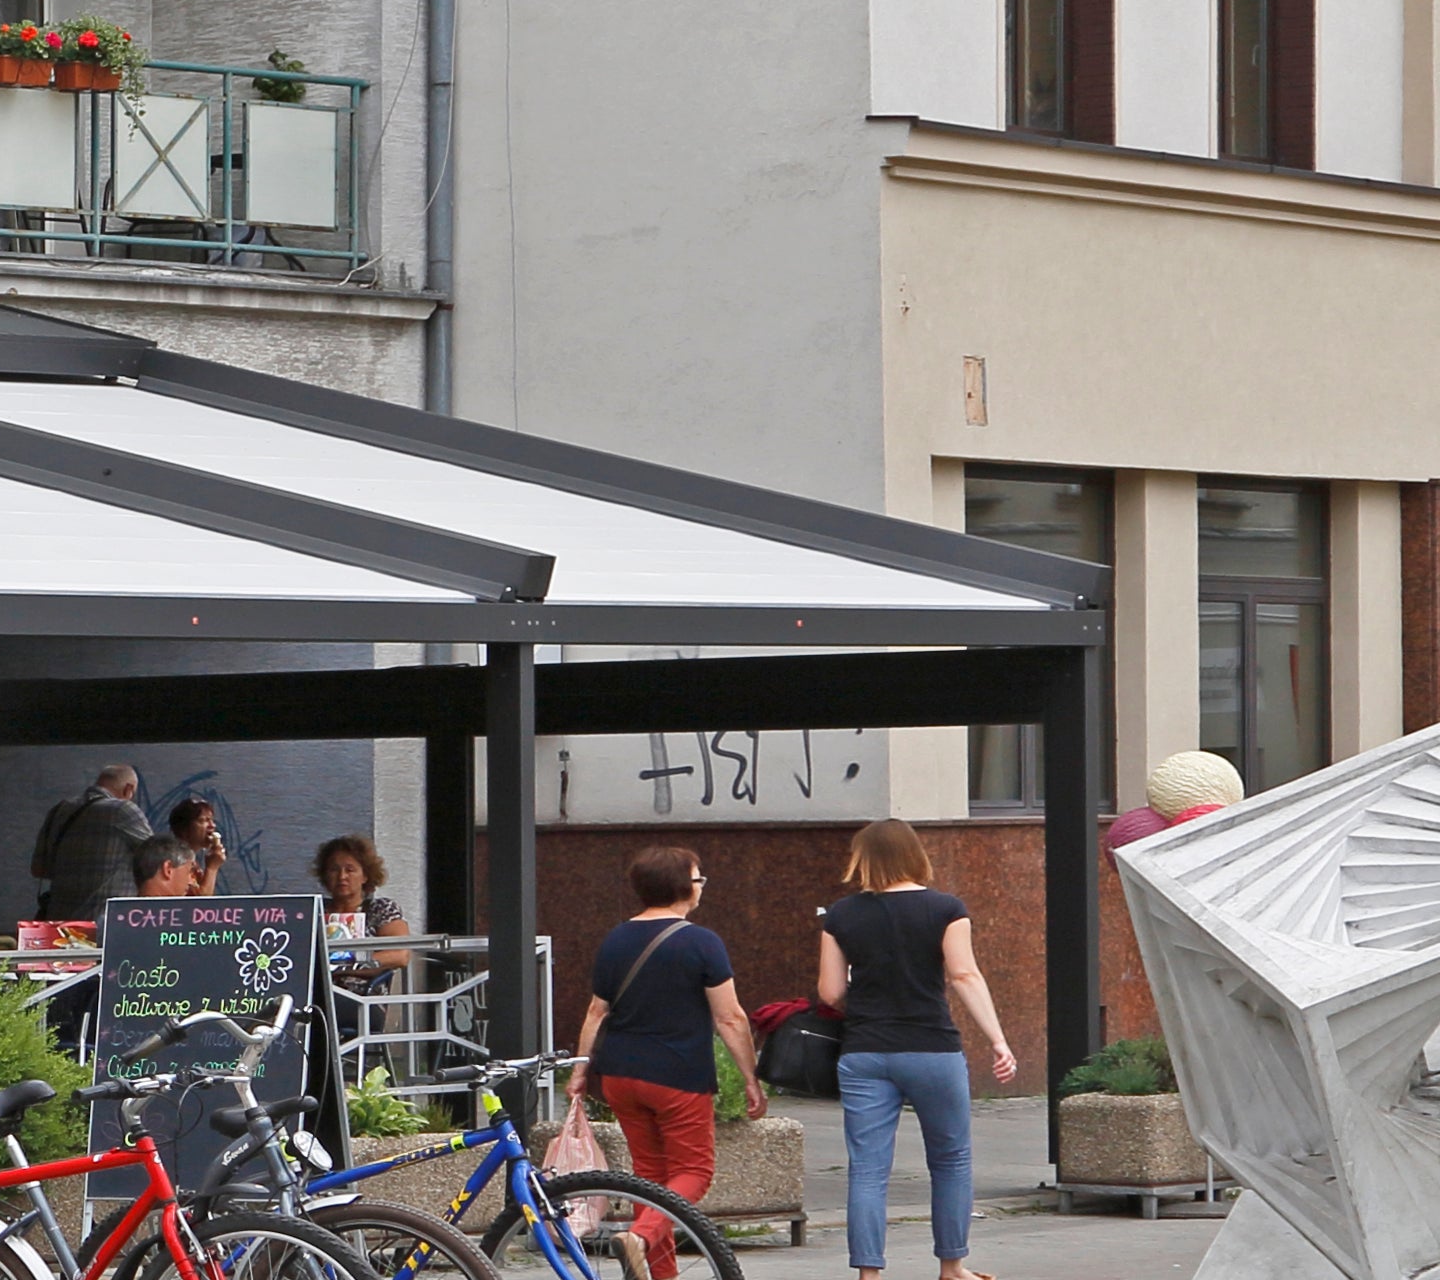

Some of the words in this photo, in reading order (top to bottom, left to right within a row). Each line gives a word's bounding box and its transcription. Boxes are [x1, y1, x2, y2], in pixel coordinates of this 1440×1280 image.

[128, 909, 183, 927] CAFE
[192, 908, 244, 925] DOLCE
[253, 907, 287, 924] VITA
[160, 930, 246, 946] POLECAMY
[117, 958, 180, 988] Ciasto
